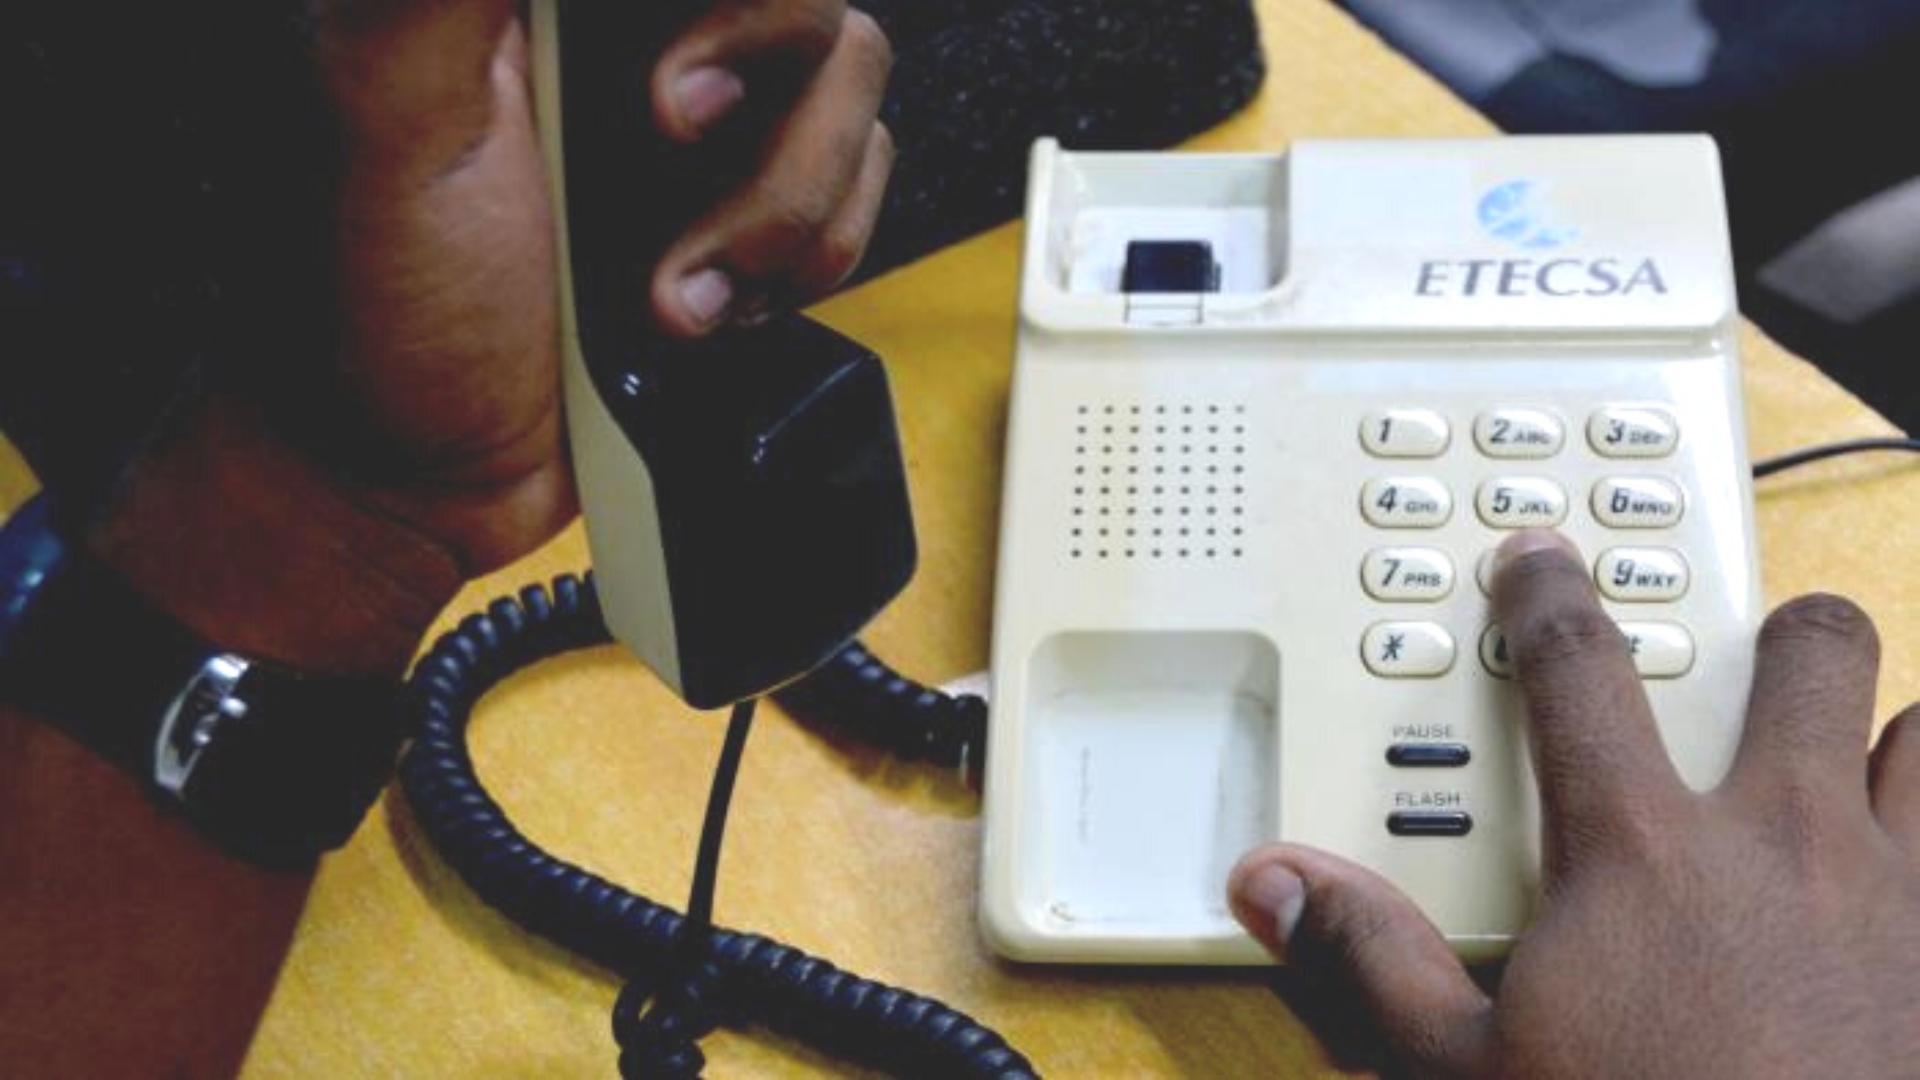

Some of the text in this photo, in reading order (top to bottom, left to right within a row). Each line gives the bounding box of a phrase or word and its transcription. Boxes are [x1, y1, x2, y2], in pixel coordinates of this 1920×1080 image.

[1414, 257, 1668, 297] ETECSA
[1378, 417, 1393, 443] 1
[1490, 418, 1511, 444] 2
[1605, 418, 1624, 444] 3
[1376, 486, 1398, 513] 4
[1492, 487, 1554, 514] 5 JKL
[1611, 487, 1630, 514] 6
[1381, 558, 1442, 587] 7 PRS
[1613, 559, 1677, 587] 9 WXY
[1392, 723, 1455, 738] PAUSE
[1395, 791, 1461, 807] FLASH
